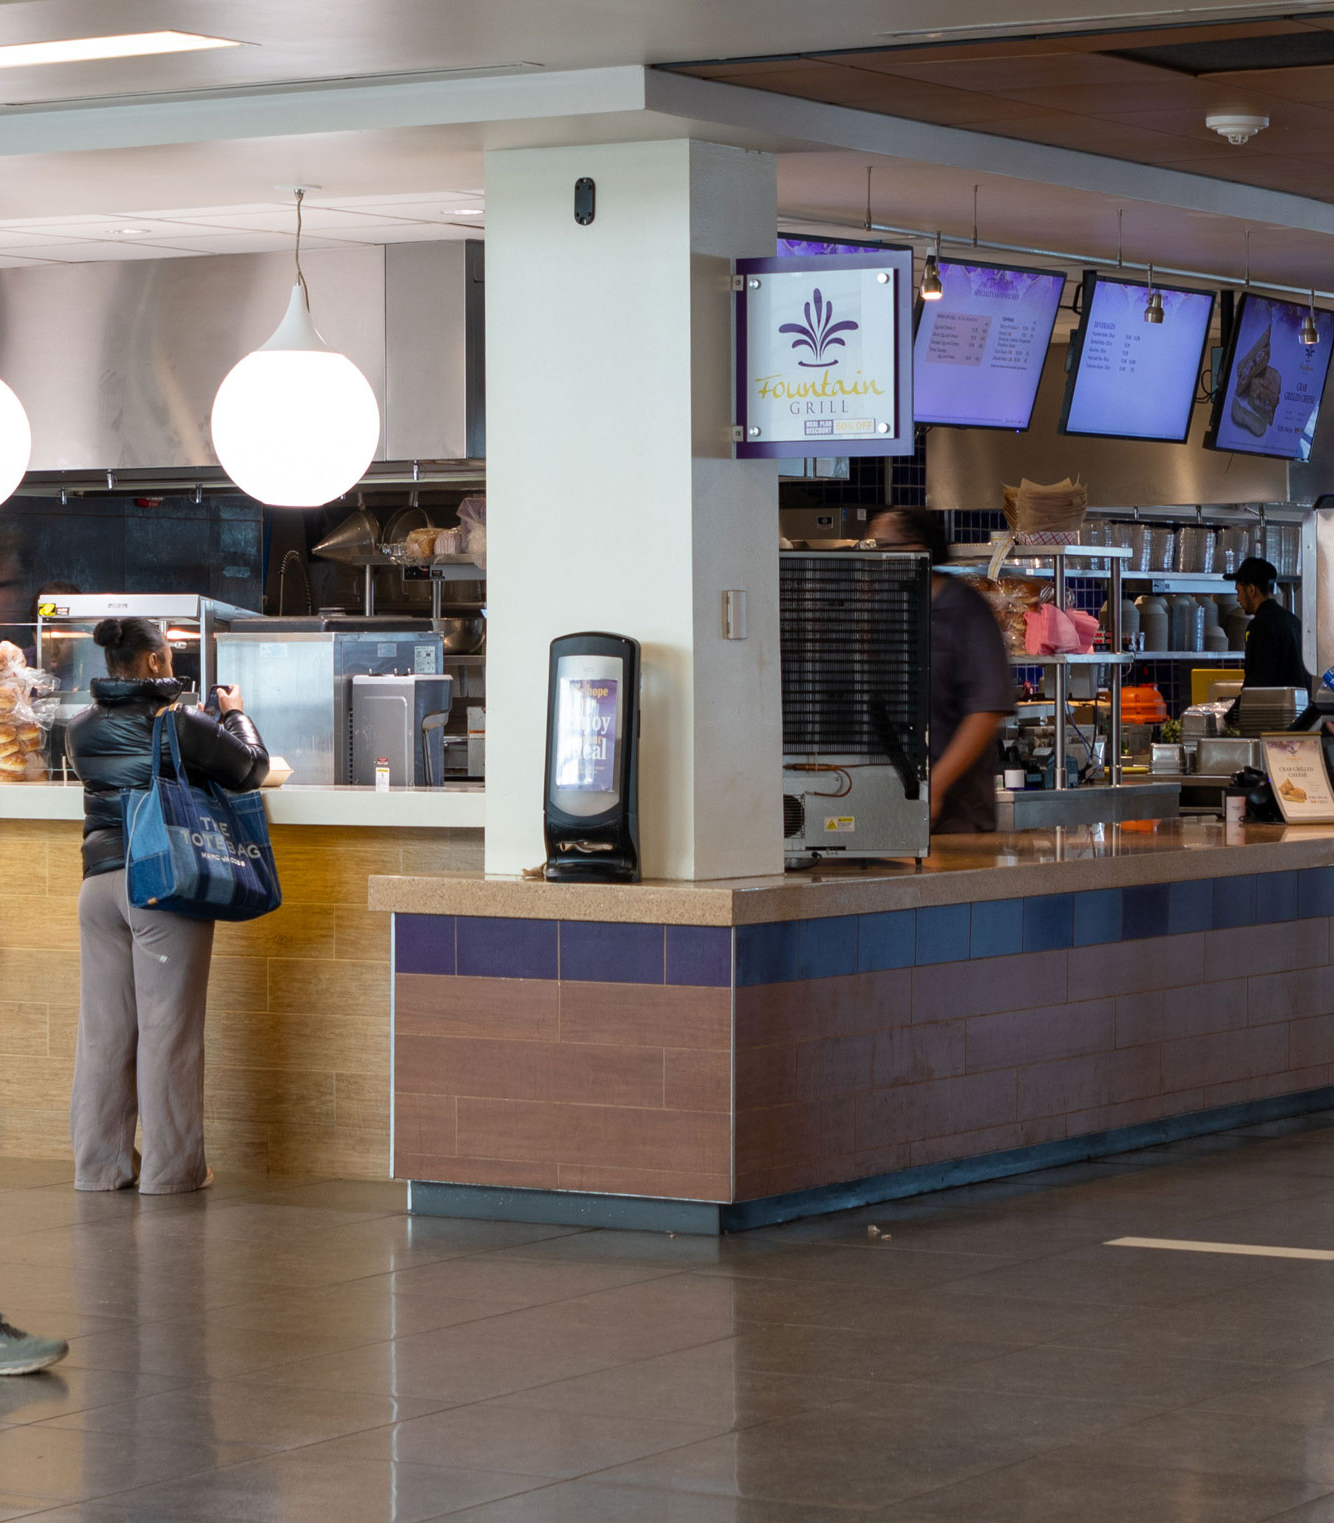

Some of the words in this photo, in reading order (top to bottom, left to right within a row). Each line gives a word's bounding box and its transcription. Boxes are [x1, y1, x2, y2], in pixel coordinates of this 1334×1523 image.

[755, 369, 885, 399] Fountain
[789, 400, 849, 415] GRILL
[179, 829, 227, 851] TOTE
[227, 841, 262, 859] BAG
